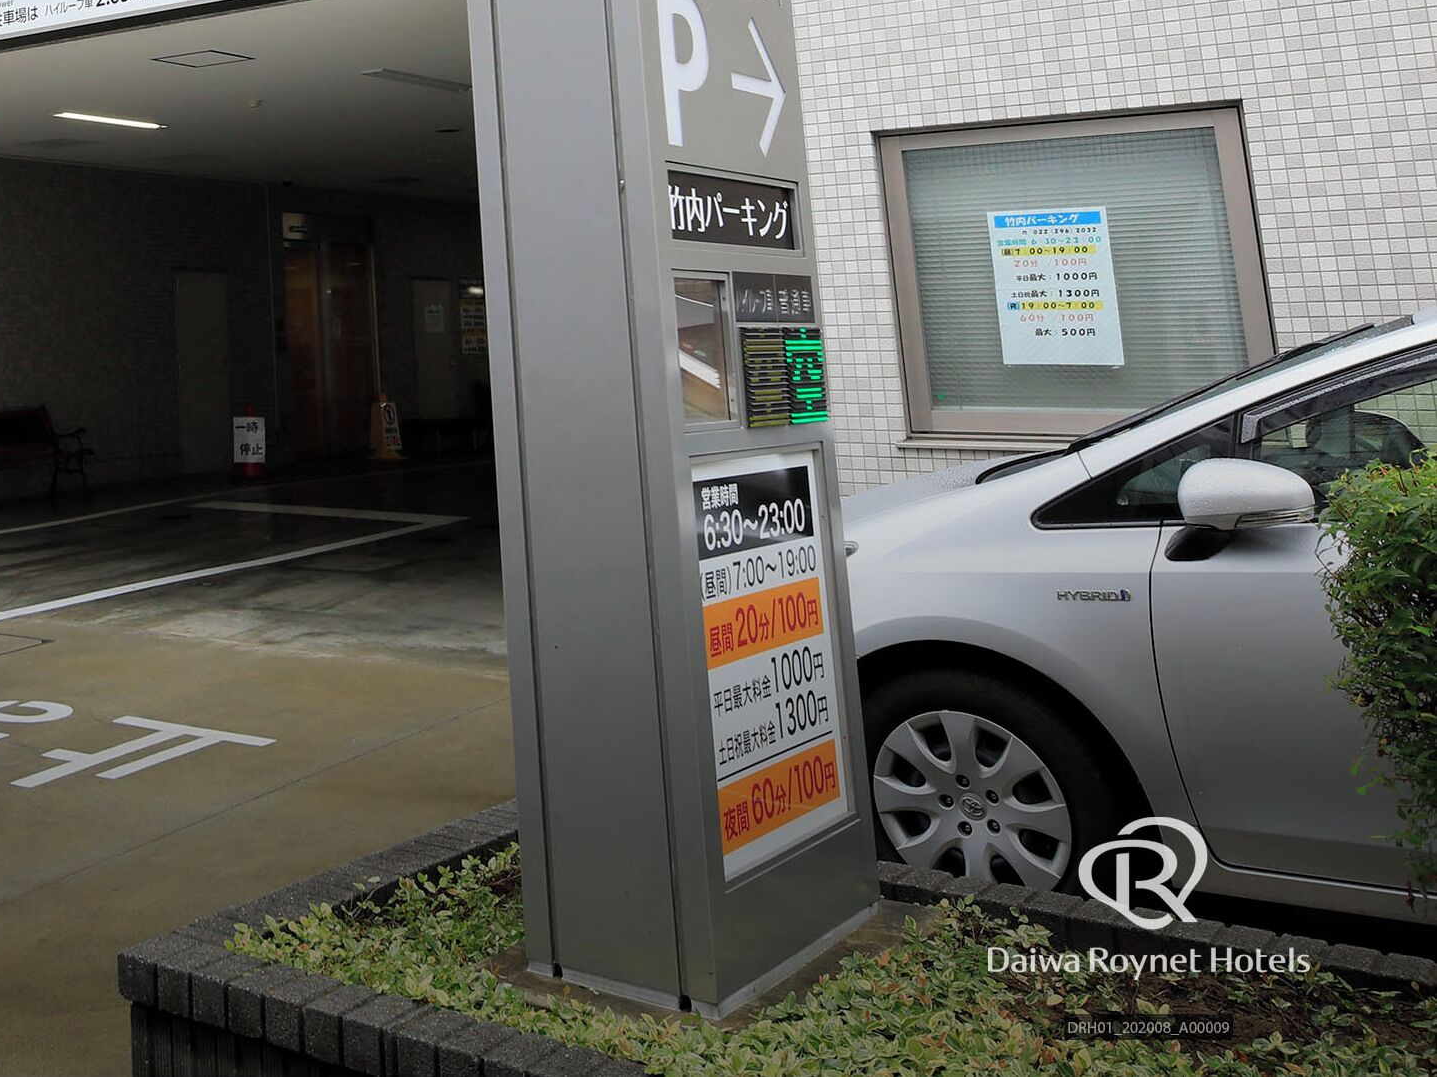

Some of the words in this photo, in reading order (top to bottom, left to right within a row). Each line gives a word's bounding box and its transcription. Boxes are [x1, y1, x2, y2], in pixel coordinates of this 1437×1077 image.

[668, 184, 788, 240] 竹内パーキング
[1005, 214, 1079, 227] 竹内パーキング
[1056, 272, 1097, 280] 1000円
[1058, 289, 1100, 297] 1300円
[1061, 328, 1096, 336] 500円
[239, 443, 263, 456] 停止
[701, 483, 739, 510] 営業時間
[700, 567, 731, 601] (昼間)
[1057, 591, 1120, 601] HYBRID
[710, 623, 733, 657] 昼間
[714, 674, 771, 716] 平日最大料金
[771, 646, 824, 693] 1000円
[719, 720, 776, 766] 土日祝最大料金
[775, 690, 829, 738] 1300円
[724, 801, 750, 842] 夜間
